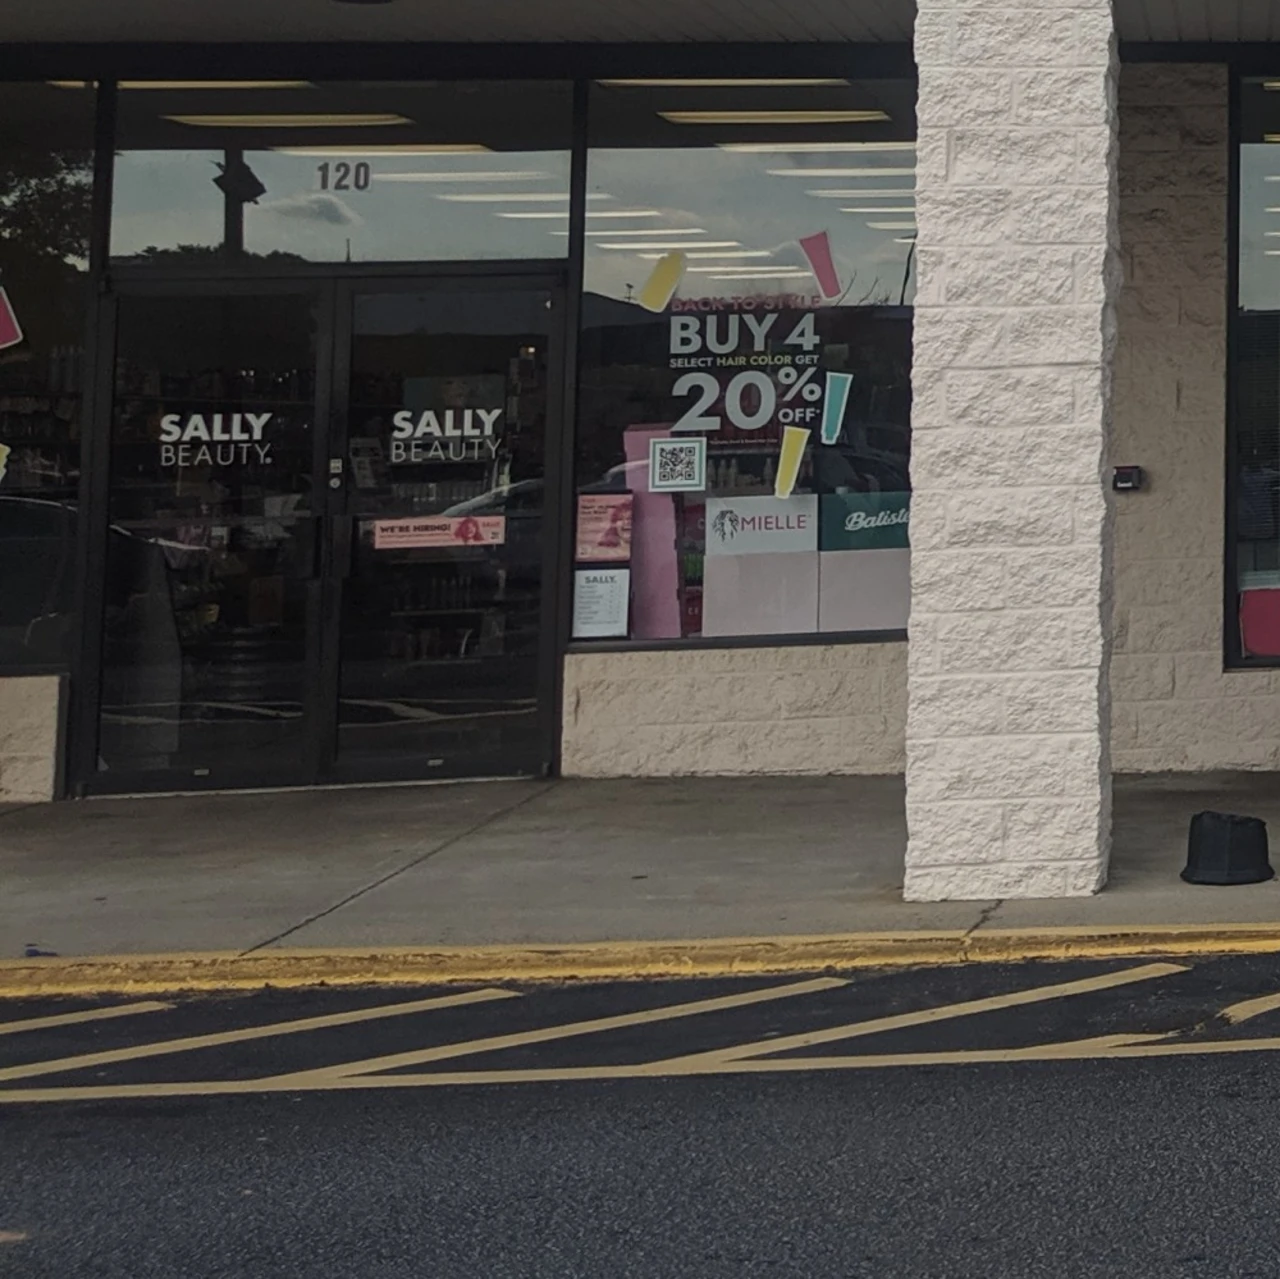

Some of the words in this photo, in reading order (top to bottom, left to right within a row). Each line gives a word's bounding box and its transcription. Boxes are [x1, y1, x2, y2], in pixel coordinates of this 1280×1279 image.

[317, 161, 371, 191] 120
[670, 297, 725, 312] BACK
[731, 296, 757, 311] TO
[669, 313, 779, 354] BUY
[784, 312, 820, 351] 4
[669, 357, 714, 368] SELECT
[716, 356, 747, 367] HAIR
[749, 355, 792, 366] COLOR
[795, 354, 820, 365] GET
[669, 366, 822, 432] 20%
[159, 412, 273, 443] SALLY
[392, 409, 503, 439] SALLY
[391, 438, 502, 463] BEAUTY
[412, 523, 451, 533] HIRING!
[740, 514, 807, 531] MIELLE
